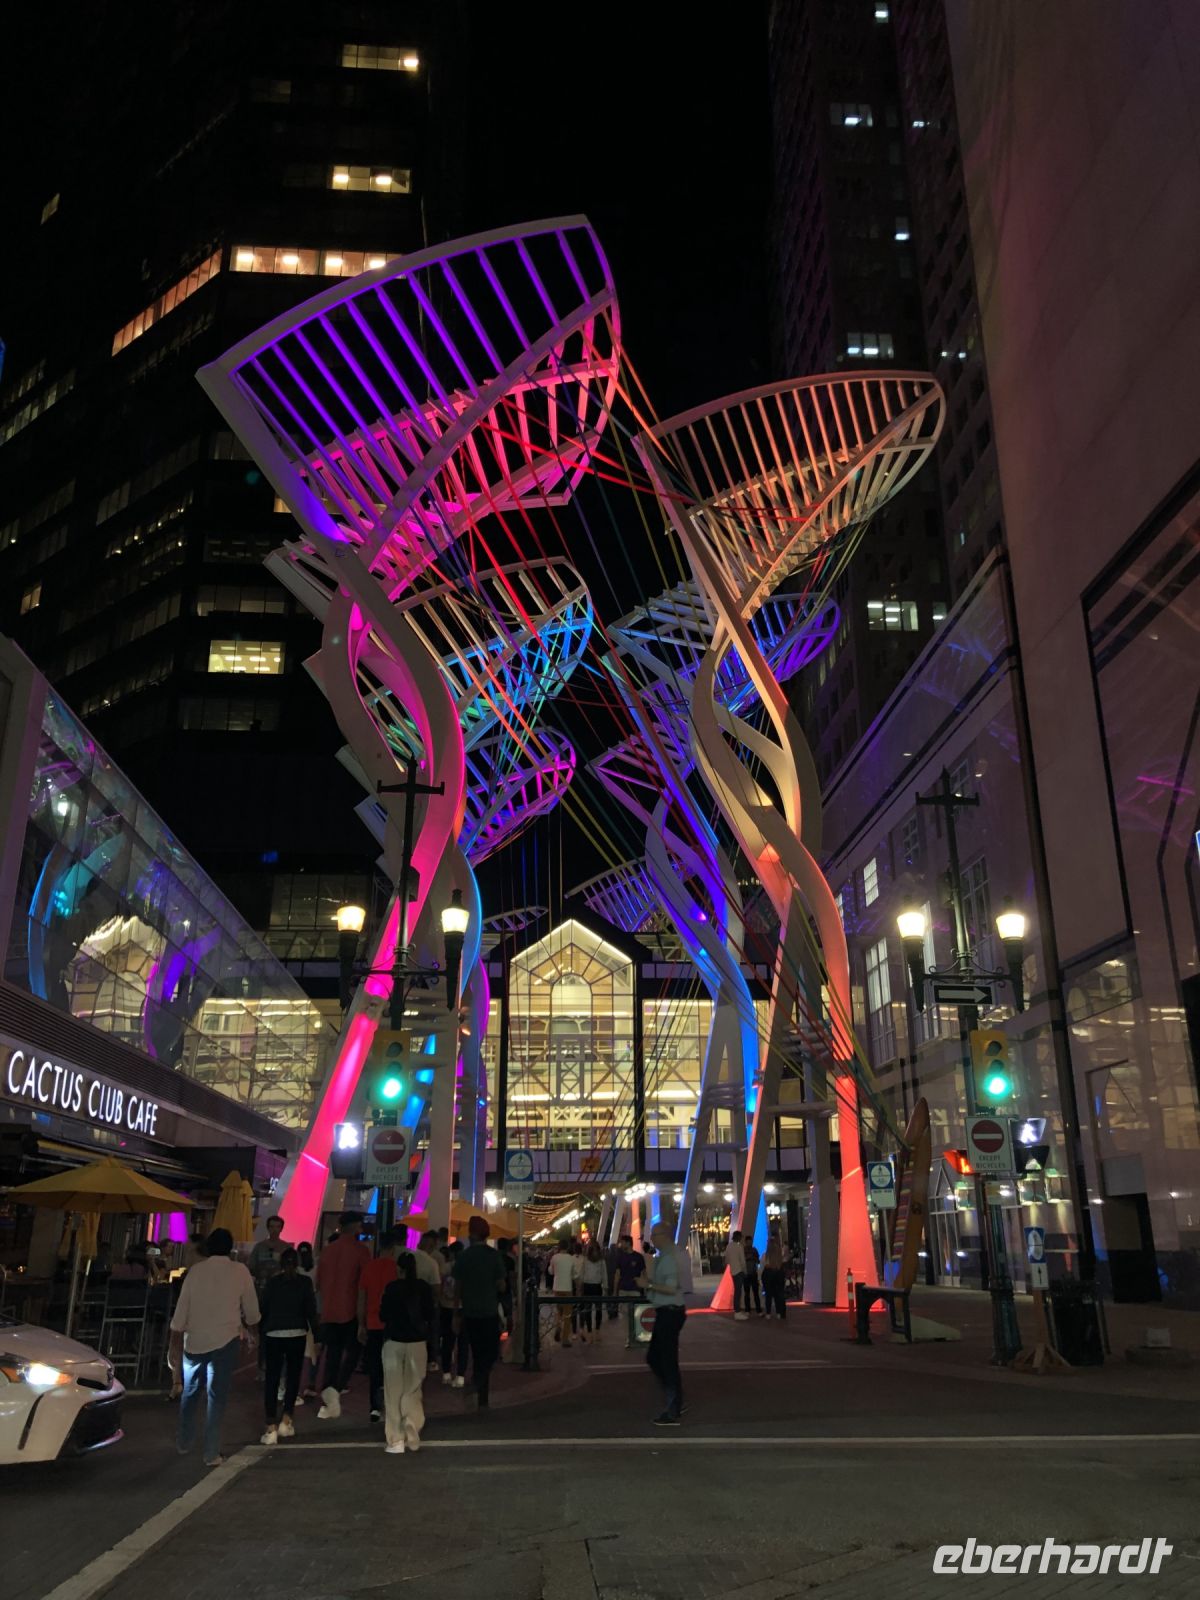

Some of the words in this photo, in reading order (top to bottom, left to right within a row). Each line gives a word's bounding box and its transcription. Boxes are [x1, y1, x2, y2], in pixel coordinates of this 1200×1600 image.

[7, 1049, 84, 1112] CACTUS
[88, 1080, 123, 1125] CLUB
[127, 1095, 159, 1136] CAFE
[978, 1154, 1001, 1162] EXCEPT
[975, 1162, 1006, 1170] BICYCLES
